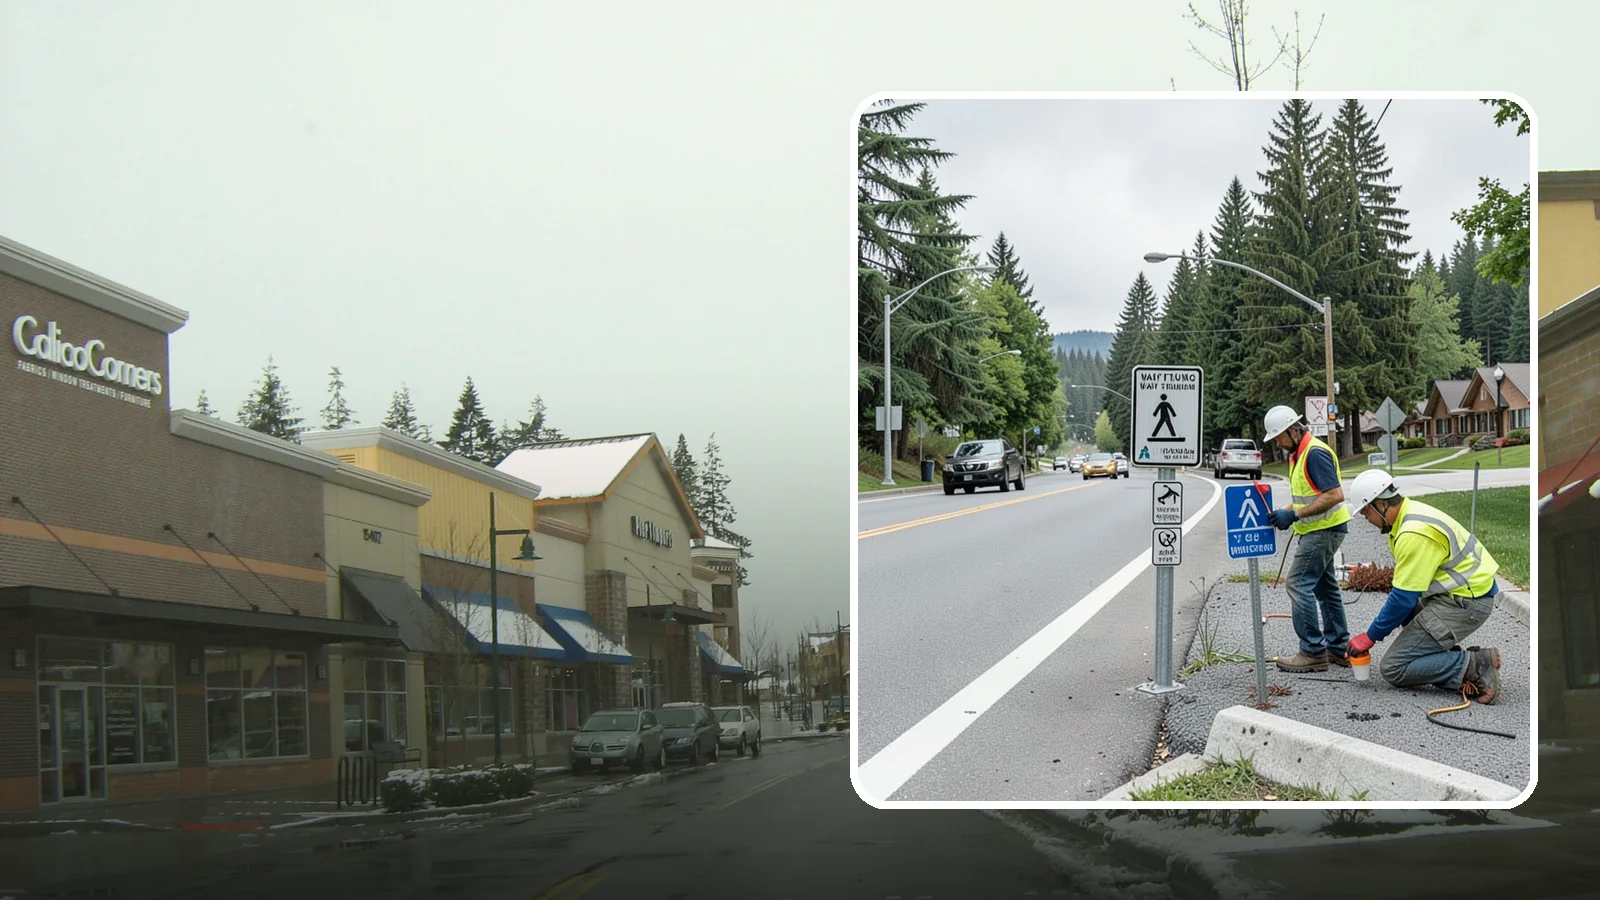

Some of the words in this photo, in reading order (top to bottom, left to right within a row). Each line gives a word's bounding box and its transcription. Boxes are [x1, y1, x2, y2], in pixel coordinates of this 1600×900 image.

[12, 315, 162, 395] CalicoCorners
[17, 360, 47, 378] FABRICS
[51, 370, 78, 387] WINDOW
[79, 378, 117, 398] TREATMENTS
[120, 391, 151, 408] FURNITURE
